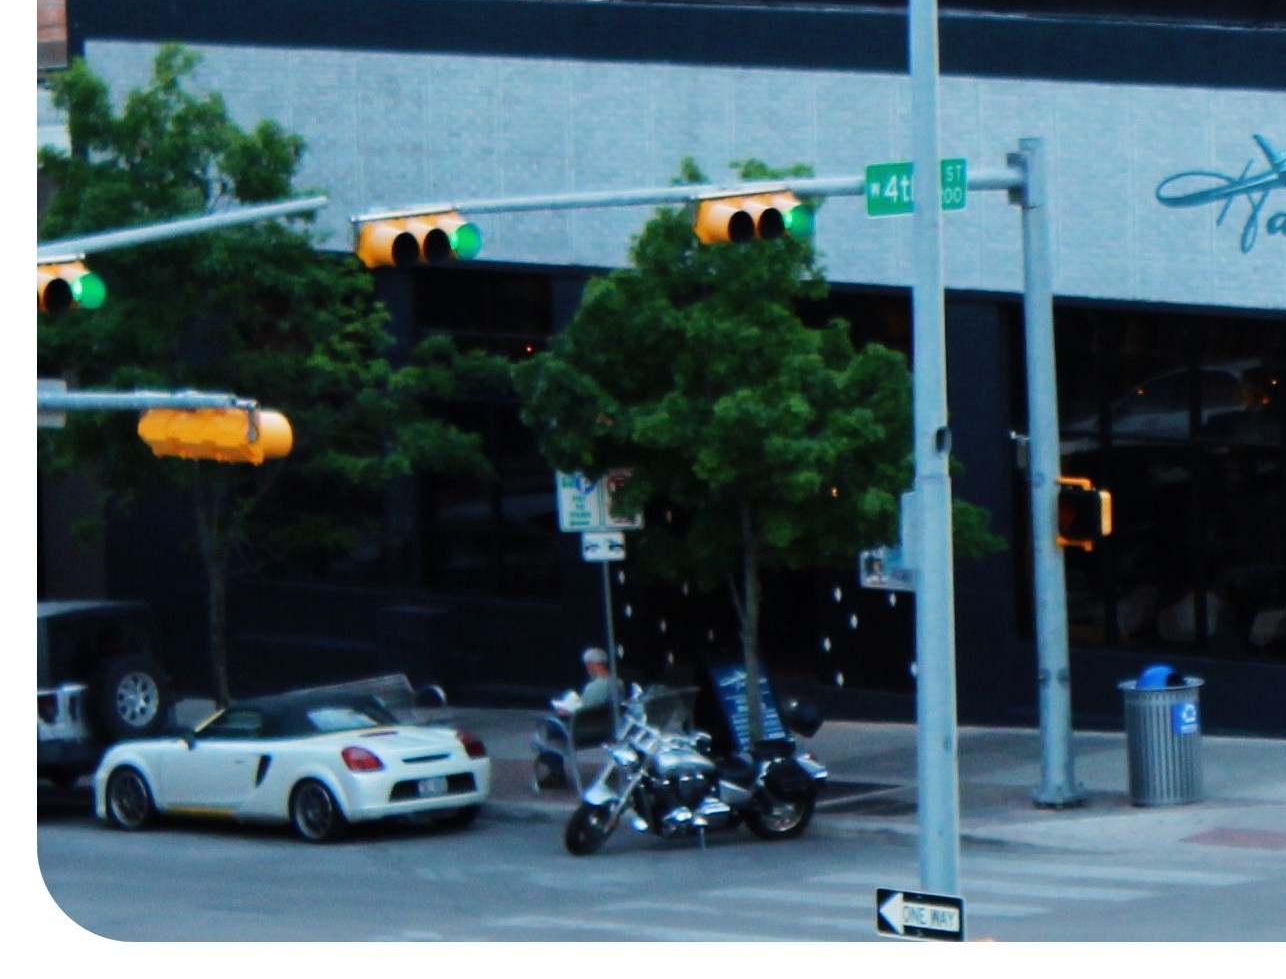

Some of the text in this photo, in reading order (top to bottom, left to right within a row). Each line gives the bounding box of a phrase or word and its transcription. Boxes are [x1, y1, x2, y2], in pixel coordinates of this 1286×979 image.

[883, 174, 914, 203] 4t
[945, 164, 962, 182] ST
[903, 904, 955, 927] ONE WAY
